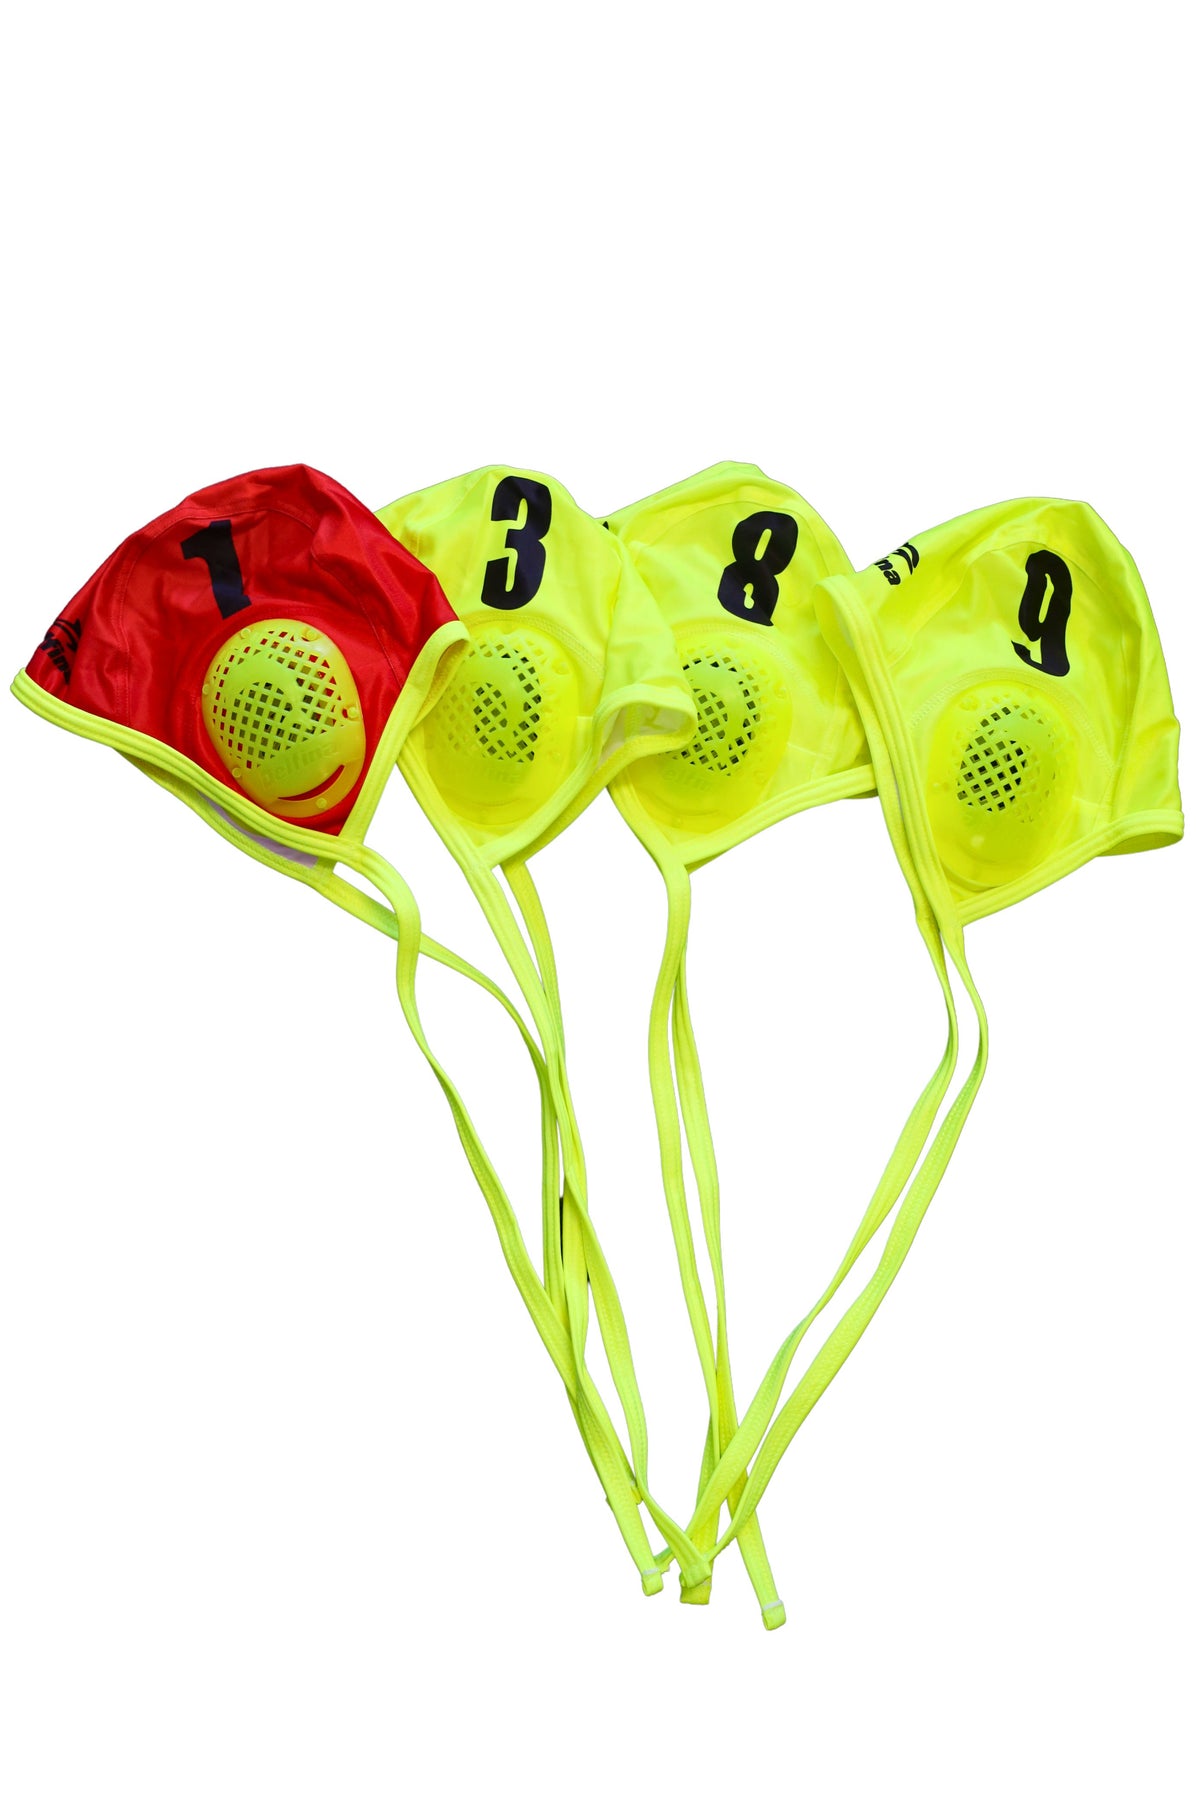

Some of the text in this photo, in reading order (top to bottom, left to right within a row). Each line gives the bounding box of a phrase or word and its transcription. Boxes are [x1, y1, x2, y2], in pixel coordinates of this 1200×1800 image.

[180, 519, 252, 620] 1
[481, 476, 552, 610] 3
[718, 511, 798, 627] 8
[1011, 550, 1072, 677] 9
